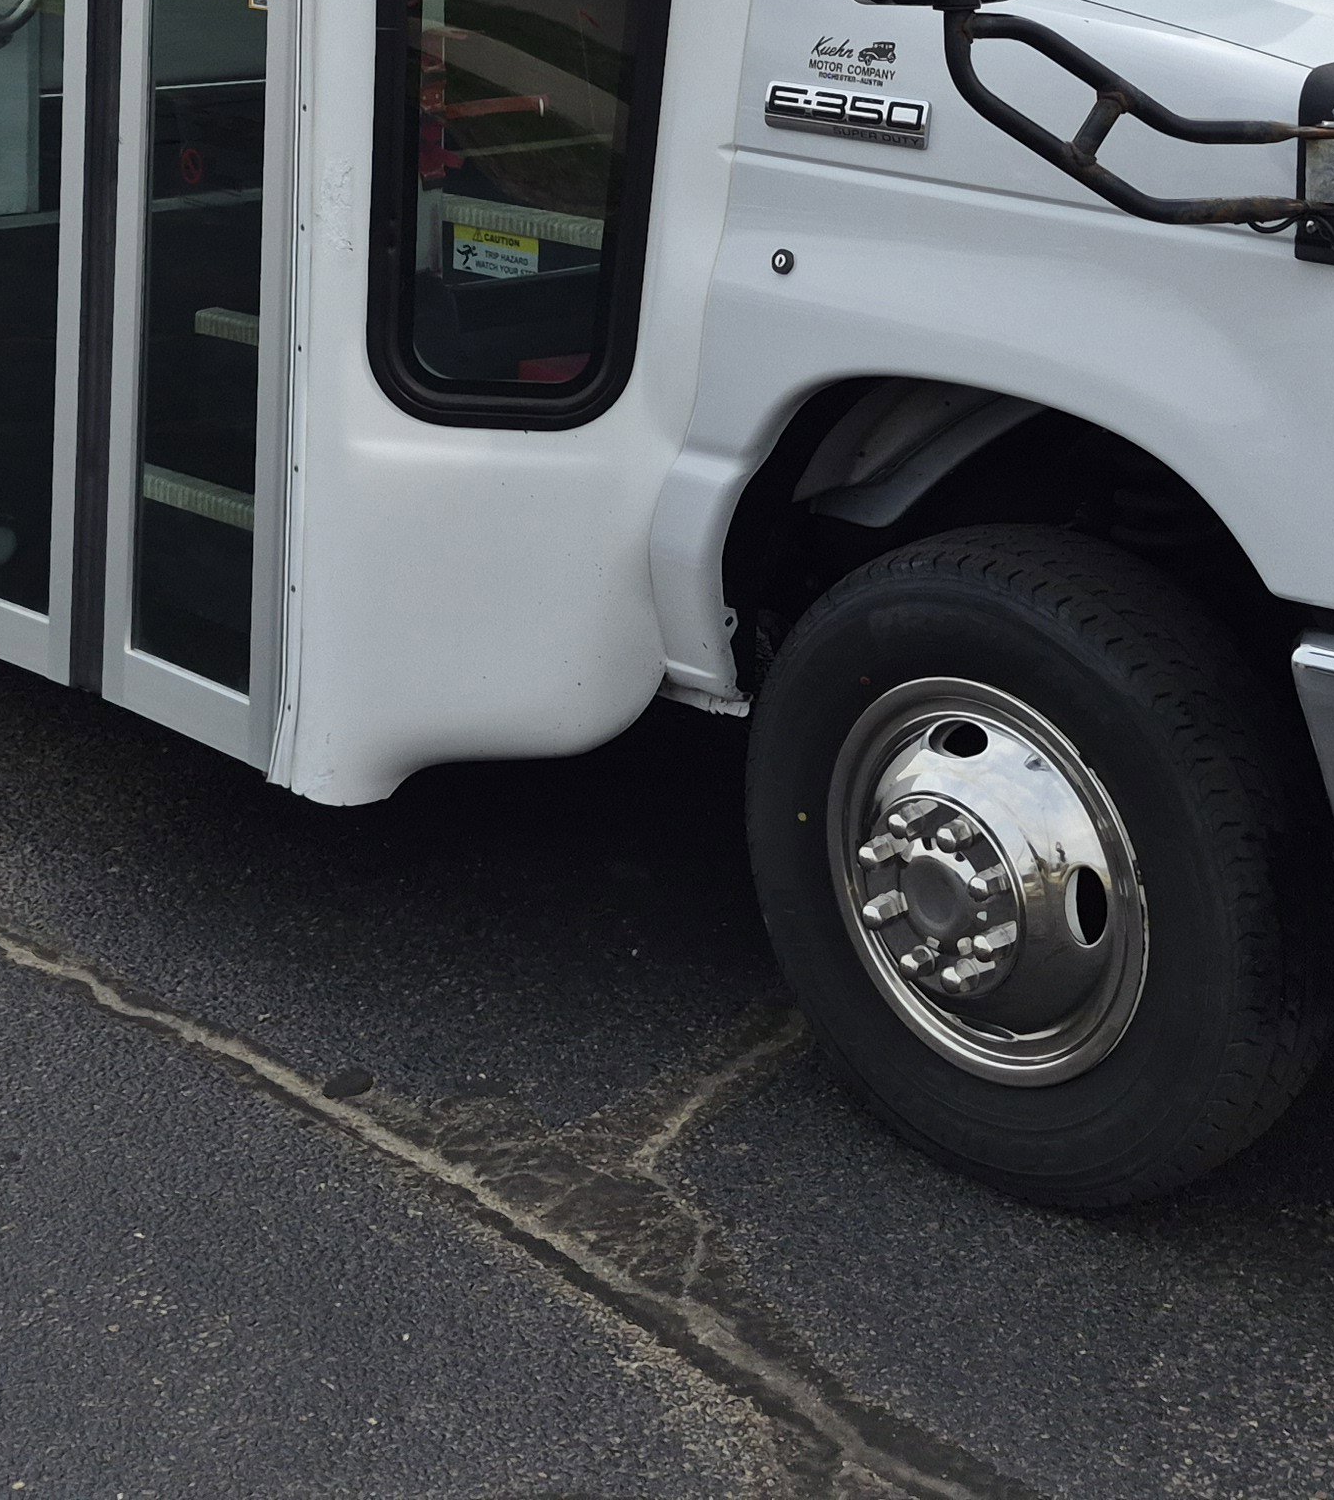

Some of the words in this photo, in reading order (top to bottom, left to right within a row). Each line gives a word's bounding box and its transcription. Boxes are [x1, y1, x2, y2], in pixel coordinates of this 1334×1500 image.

[810, 35, 854, 59] Kuehn
[808, 59, 843, 73] MOTOR
[847, 64, 896, 81] COMPANY
[832, 126, 880, 142] SUPER
[882, 133, 920, 146] DUTY
[483, 233, 521, 248] CAUTION
[484, 250, 500, 261] TRIP
[501, 254, 529, 266] HAZARD
[475, 260, 498, 271] WATCH
[499, 265, 519, 276] YOUR
